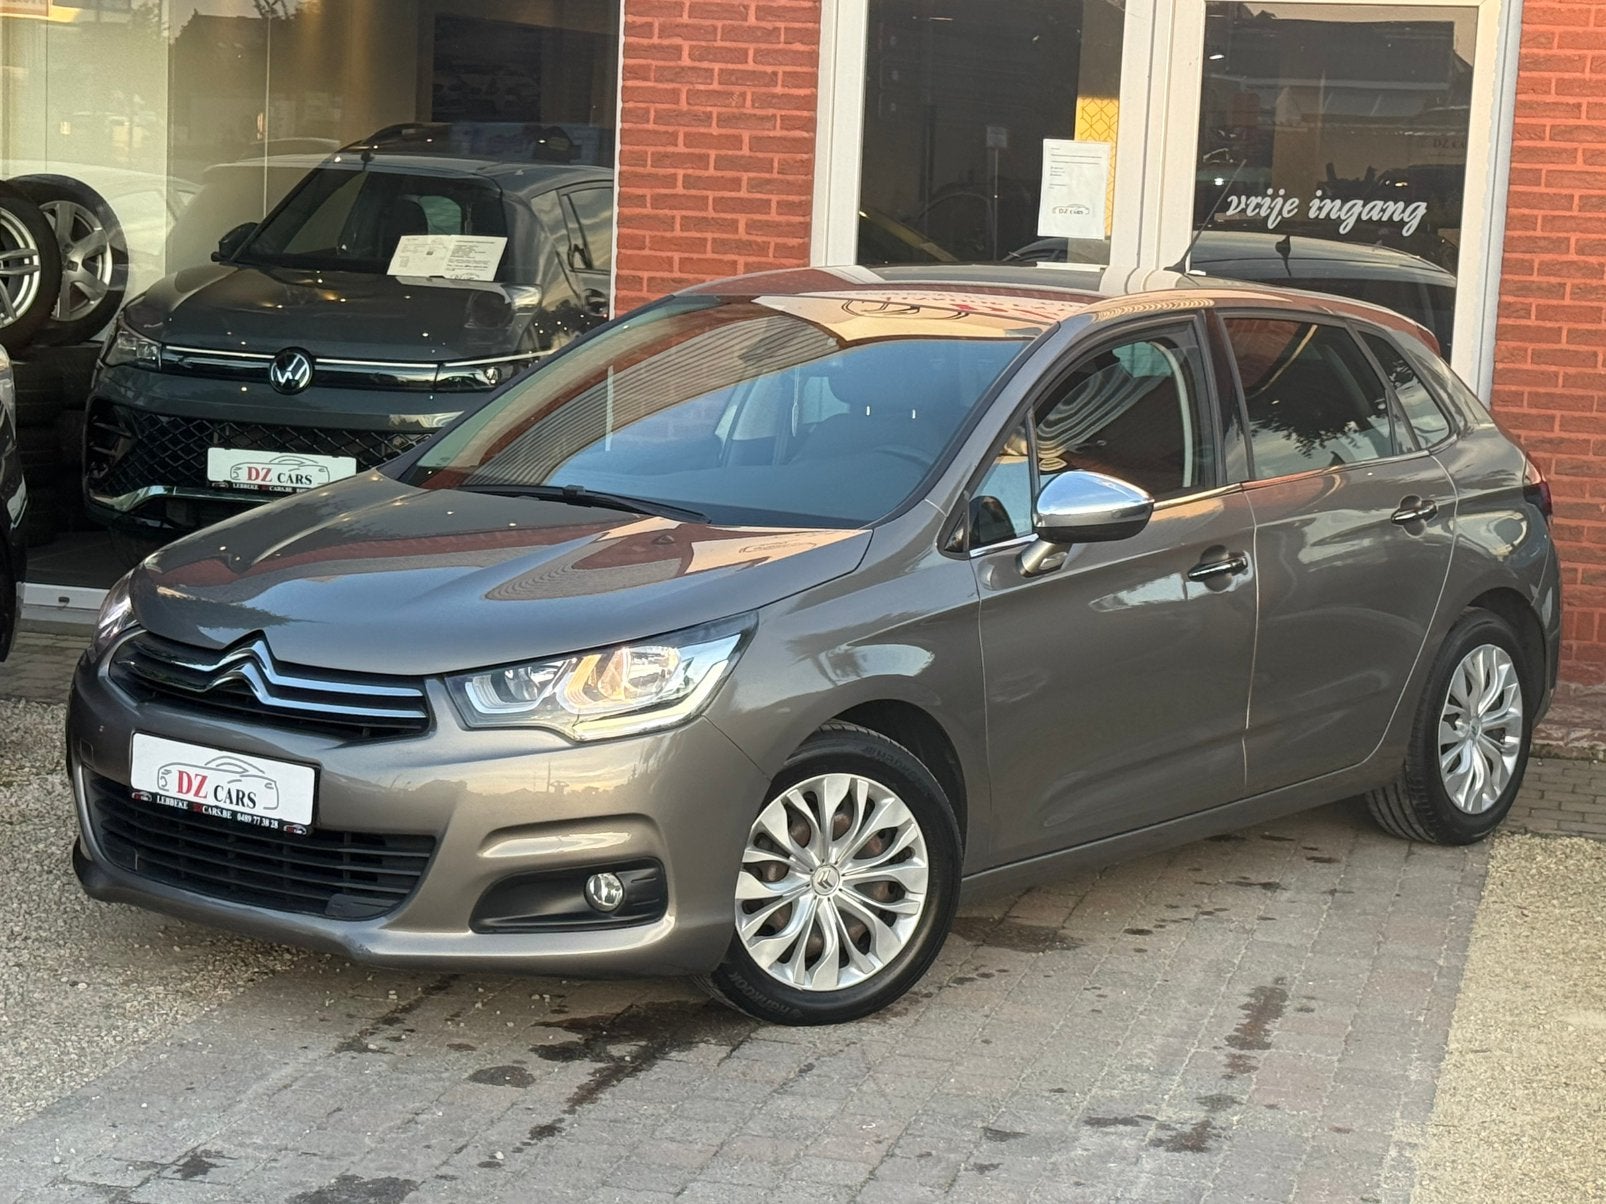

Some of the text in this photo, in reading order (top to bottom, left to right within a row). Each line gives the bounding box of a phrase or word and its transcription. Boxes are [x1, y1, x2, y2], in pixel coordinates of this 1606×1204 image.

[1226, 188, 1428, 237] vrije ingang
[247, 466, 313, 485] DZ CARS
[176, 769, 208, 799] DZ
[213, 784, 257, 809] CARS
[156, 795, 189, 810] LEBBEKE
[253, 815, 261, 826] 77
